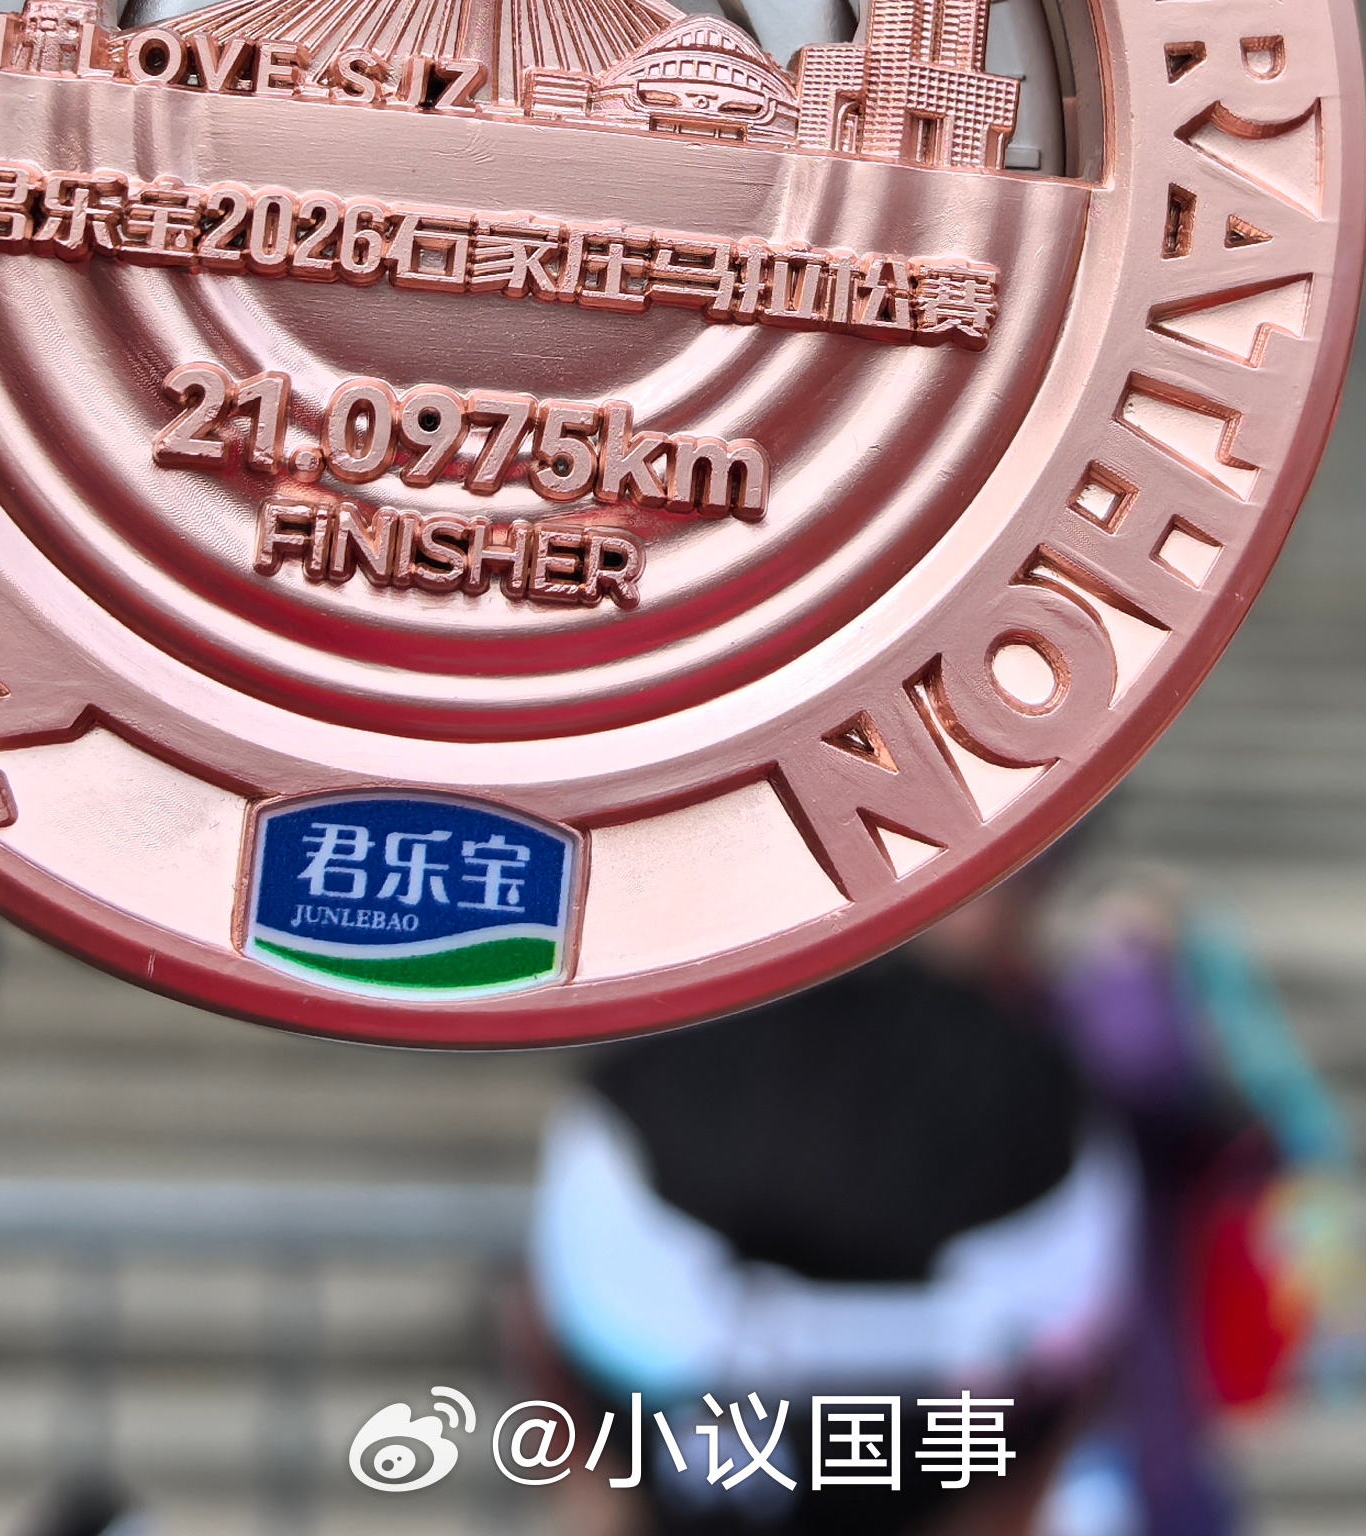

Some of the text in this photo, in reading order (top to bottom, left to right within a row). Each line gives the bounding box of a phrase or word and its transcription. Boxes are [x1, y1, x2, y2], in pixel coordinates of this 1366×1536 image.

[75, 16, 309, 98] LOVE
[334, 47, 487, 112] SJZ
[153, 361, 770, 522] 21.0975km
[254, 494, 647, 608] FINISHER
[296, 821, 532, 914] 君乐宝
[289, 903, 421, 933] JUNLEBAO
